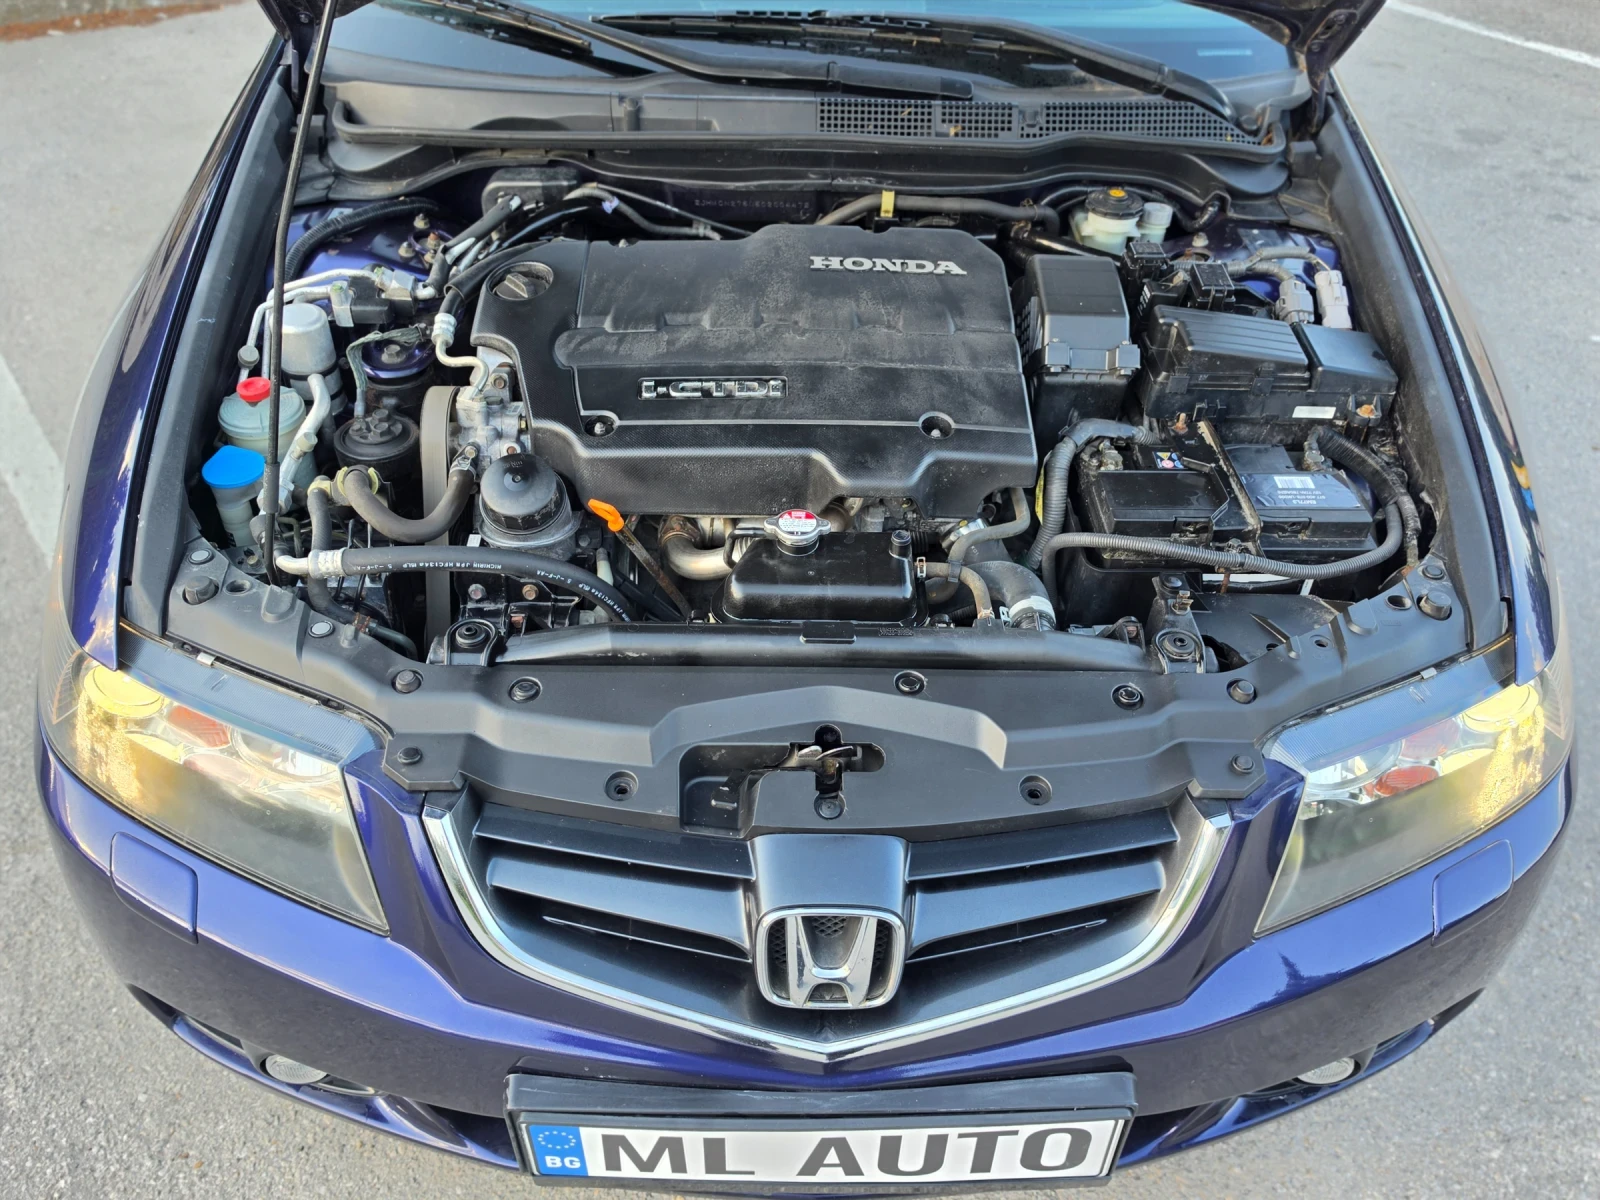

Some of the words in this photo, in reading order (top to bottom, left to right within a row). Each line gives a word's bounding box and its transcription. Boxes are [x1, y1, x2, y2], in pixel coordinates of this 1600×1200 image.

[810, 256, 967, 275] HONDA
[601, 1133, 756, 1175] ML
[796, 1127, 1093, 1177] AUTO
[545, 1156, 581, 1168] BG
